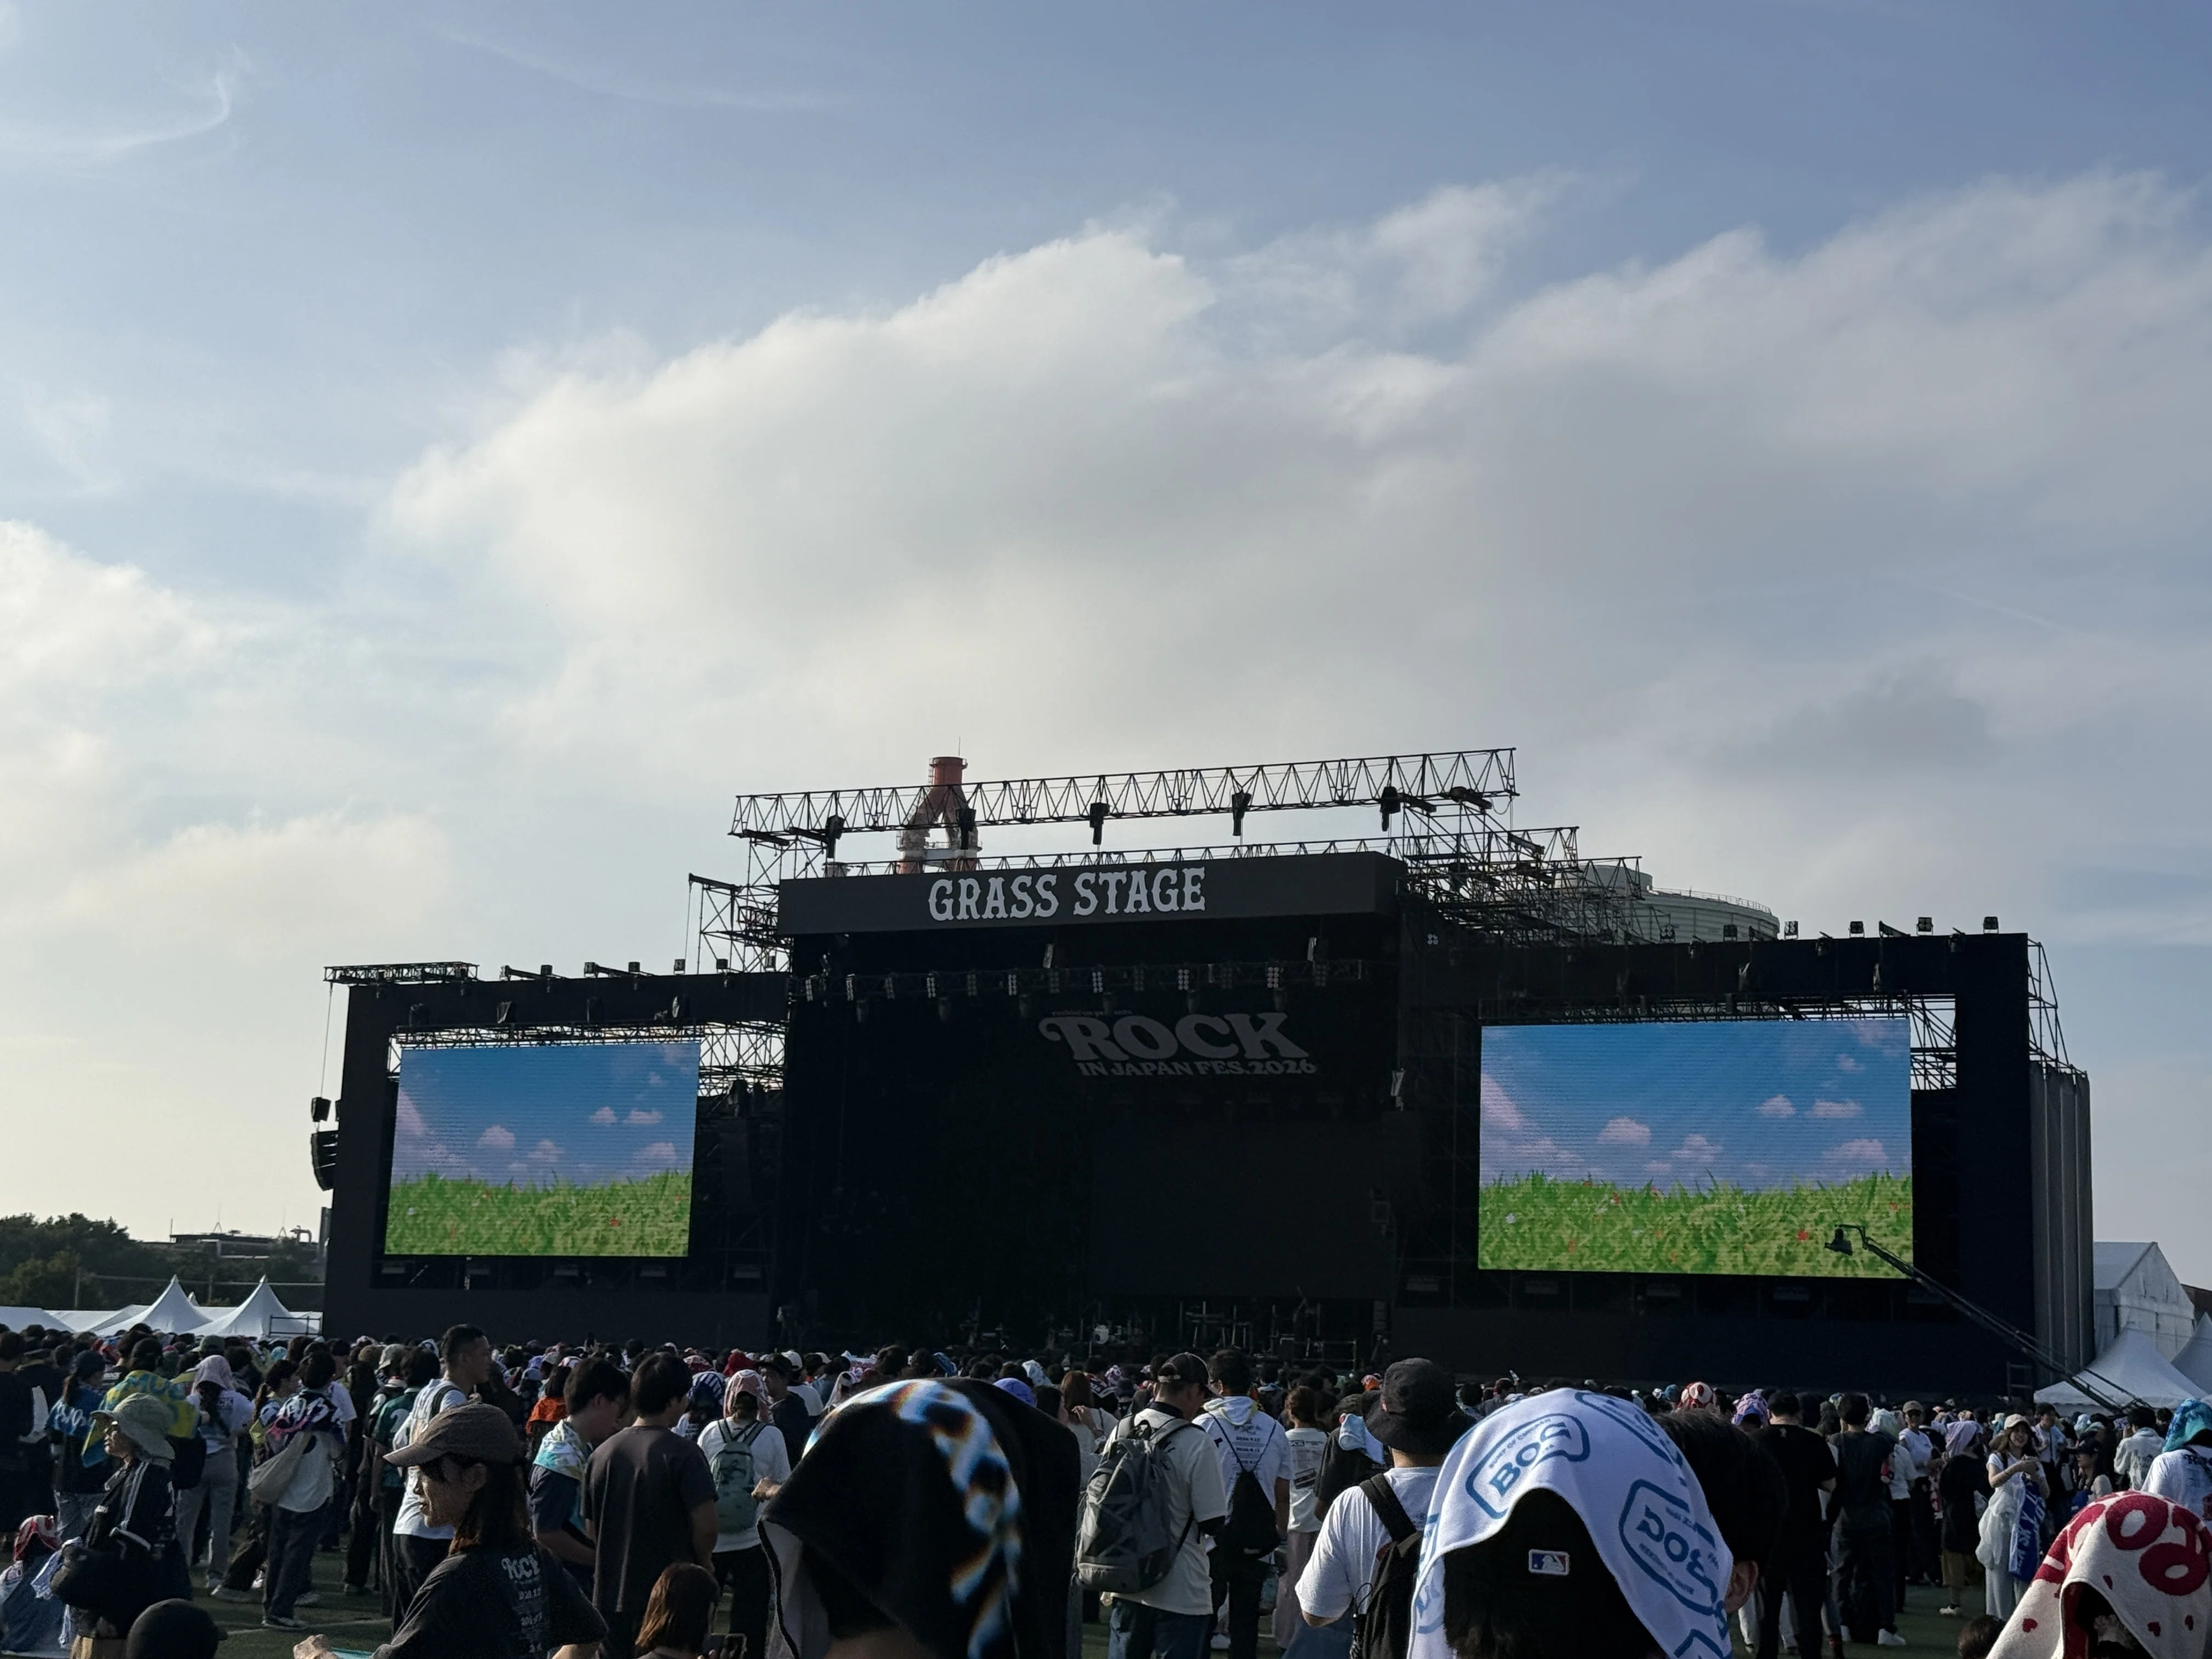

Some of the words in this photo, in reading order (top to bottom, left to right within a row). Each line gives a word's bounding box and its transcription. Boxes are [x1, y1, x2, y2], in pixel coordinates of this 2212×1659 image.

[928, 874, 1060, 921] GRASS
[1073, 867, 1206, 916] STAGE
[1039, 1012, 1309, 1060] ROCK
[1076, 1062, 1109, 1076] IN
[1110, 1062, 1197, 1076] JAPAN
[1507, 1439, 1516, 1449] OF
